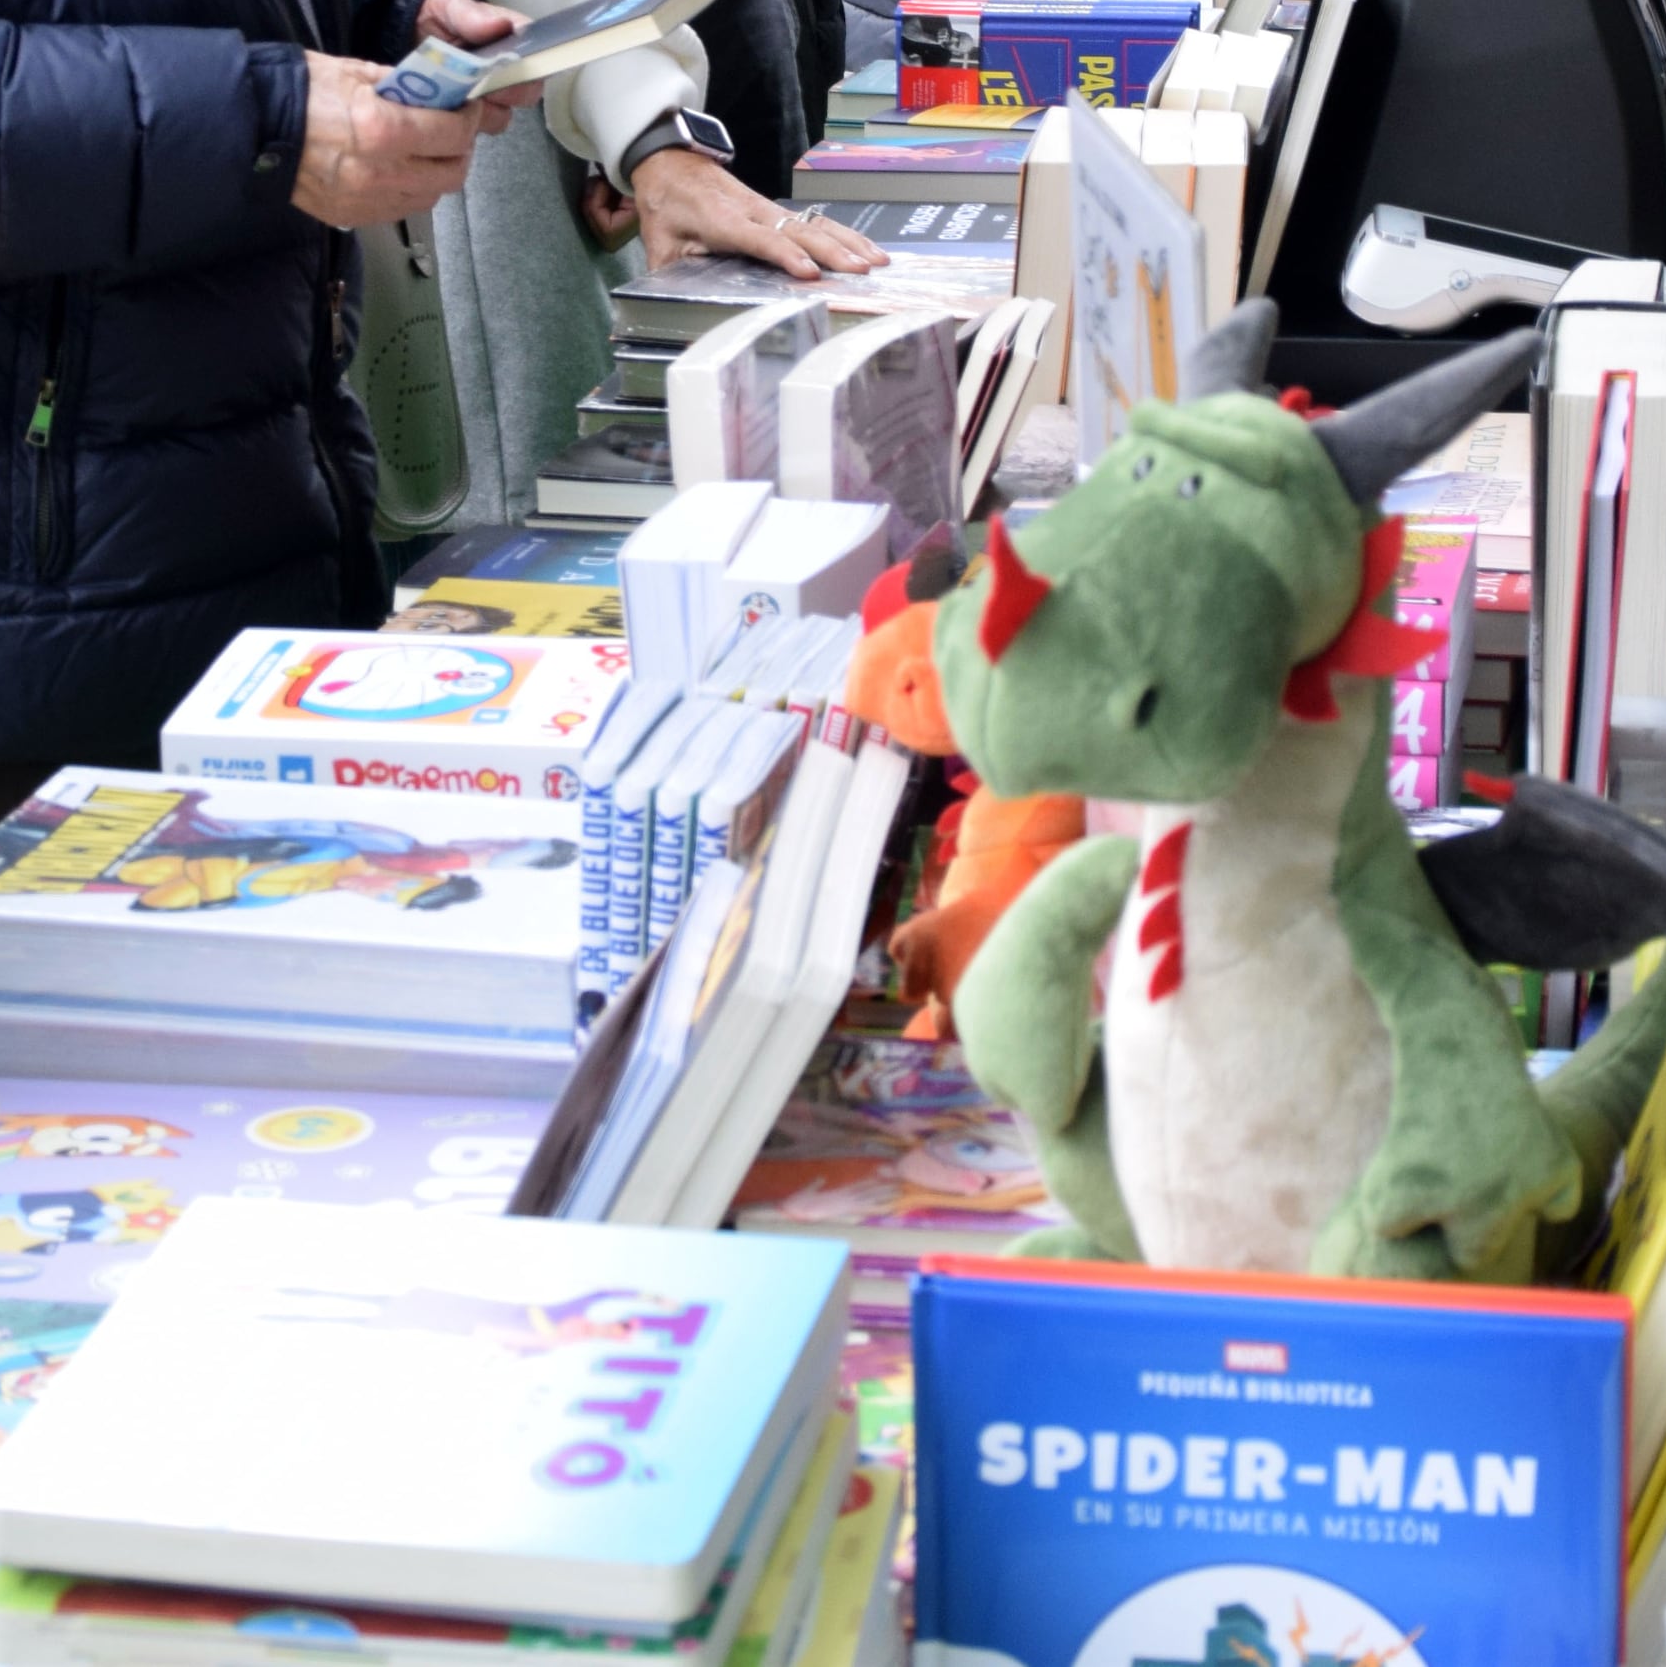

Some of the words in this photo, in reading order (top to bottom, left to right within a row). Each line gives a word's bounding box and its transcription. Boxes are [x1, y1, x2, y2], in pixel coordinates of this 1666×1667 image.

[201, 757, 266, 771] FUJIKO
[332, 757, 522, 797] Doraemon
[580, 782, 613, 932] BLUELOCK
[611, 806, 646, 956] BLUELOCK
[1139, 1371, 1239, 1400] PEQUEÑA
[1244, 1379, 1374, 1409] BIBLIOTECA
[977, 1421, 1538, 1517] SPIDER-MAN
[1075, 1498, 1113, 1524] EN
[1127, 1501, 1163, 1528] SU
[1175, 1505, 1310, 1537] PRIMERA
[1323, 1511, 1441, 1545] MISIÓN
